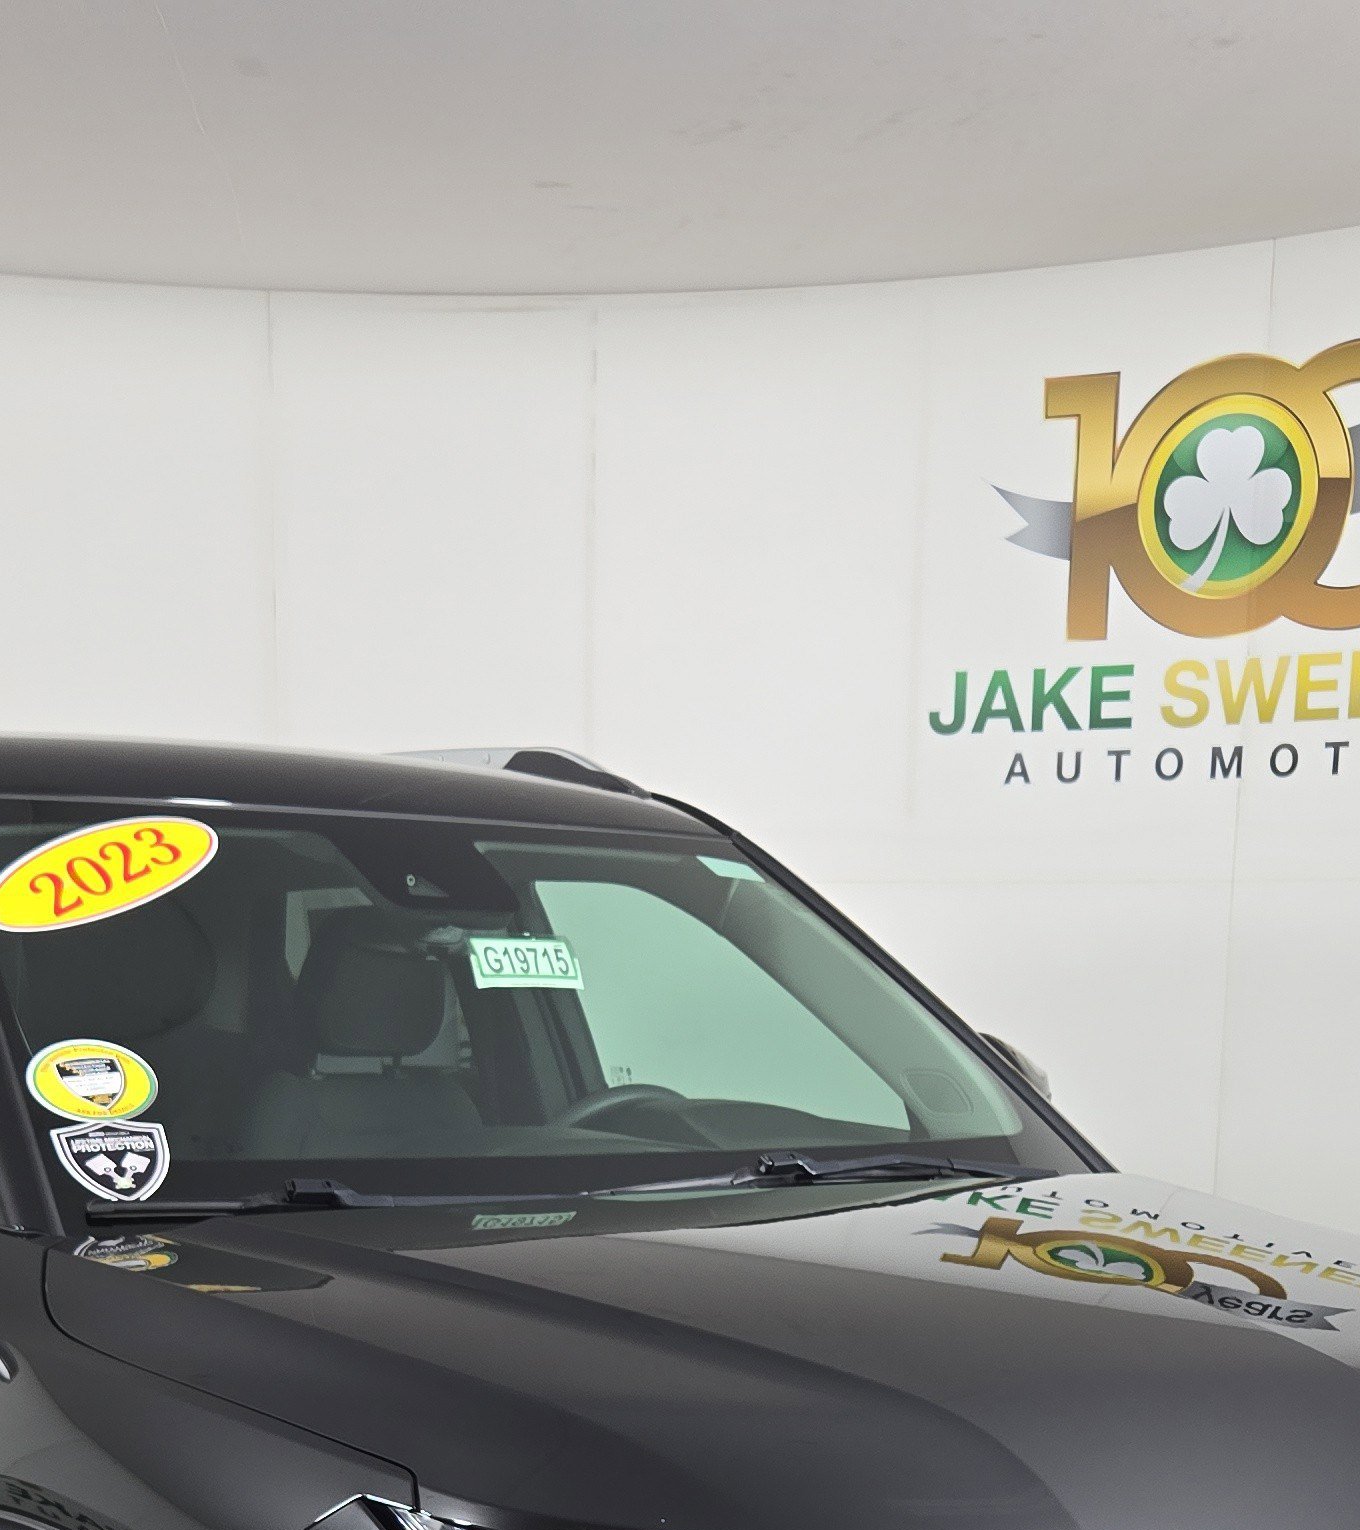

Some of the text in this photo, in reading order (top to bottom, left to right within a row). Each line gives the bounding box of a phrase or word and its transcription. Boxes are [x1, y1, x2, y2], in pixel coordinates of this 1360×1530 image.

[929, 664, 1134, 735] JAKE
[29, 827, 181, 916] 2023
[483, 946, 569, 976] G19715
